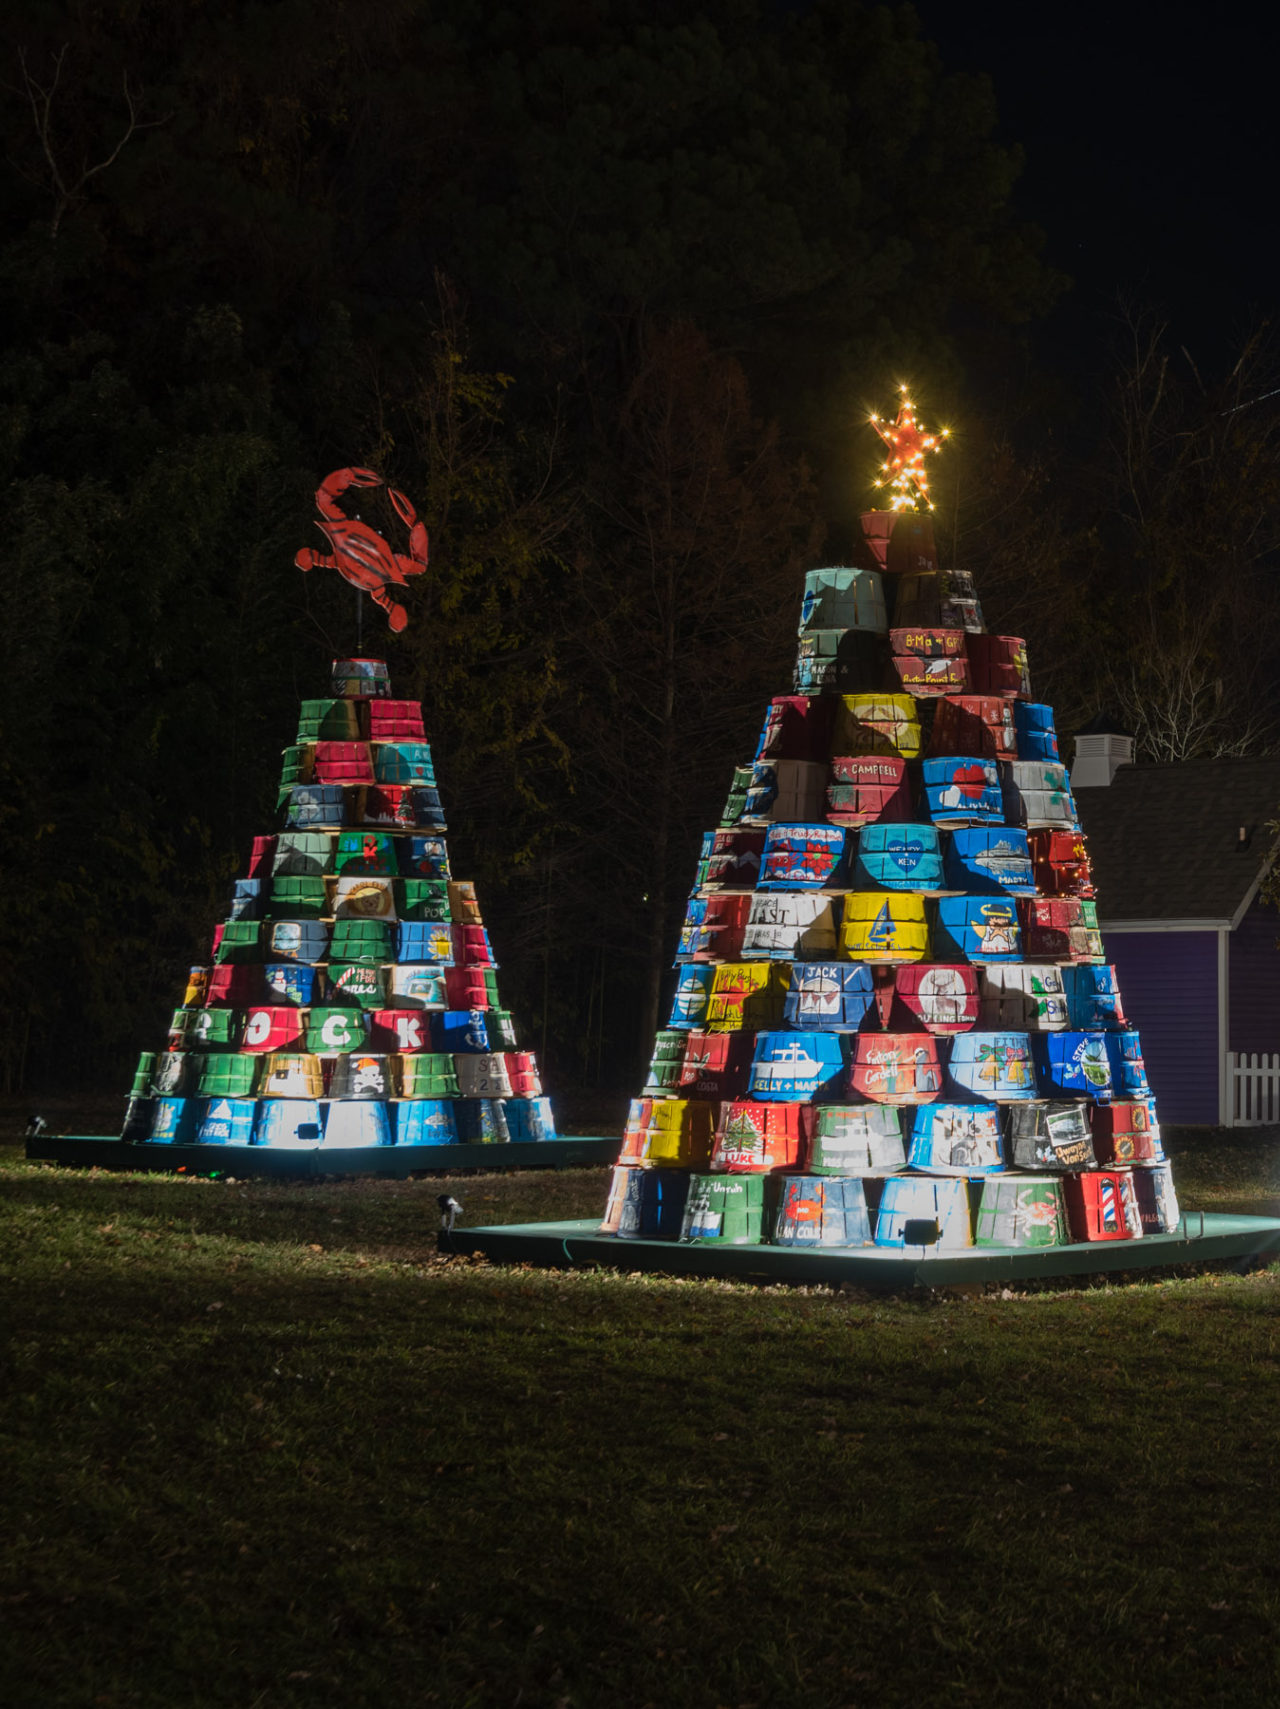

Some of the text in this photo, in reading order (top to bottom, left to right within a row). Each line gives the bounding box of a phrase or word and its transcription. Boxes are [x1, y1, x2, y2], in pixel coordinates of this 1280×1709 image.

[852, 764, 898, 777] CAMPBELL
[897, 857, 916, 866] KEN
[807, 967, 838, 978] JACK
[1072, 1037, 1090, 1062] STEVE
[754, 1080, 781, 1092] KELLY
